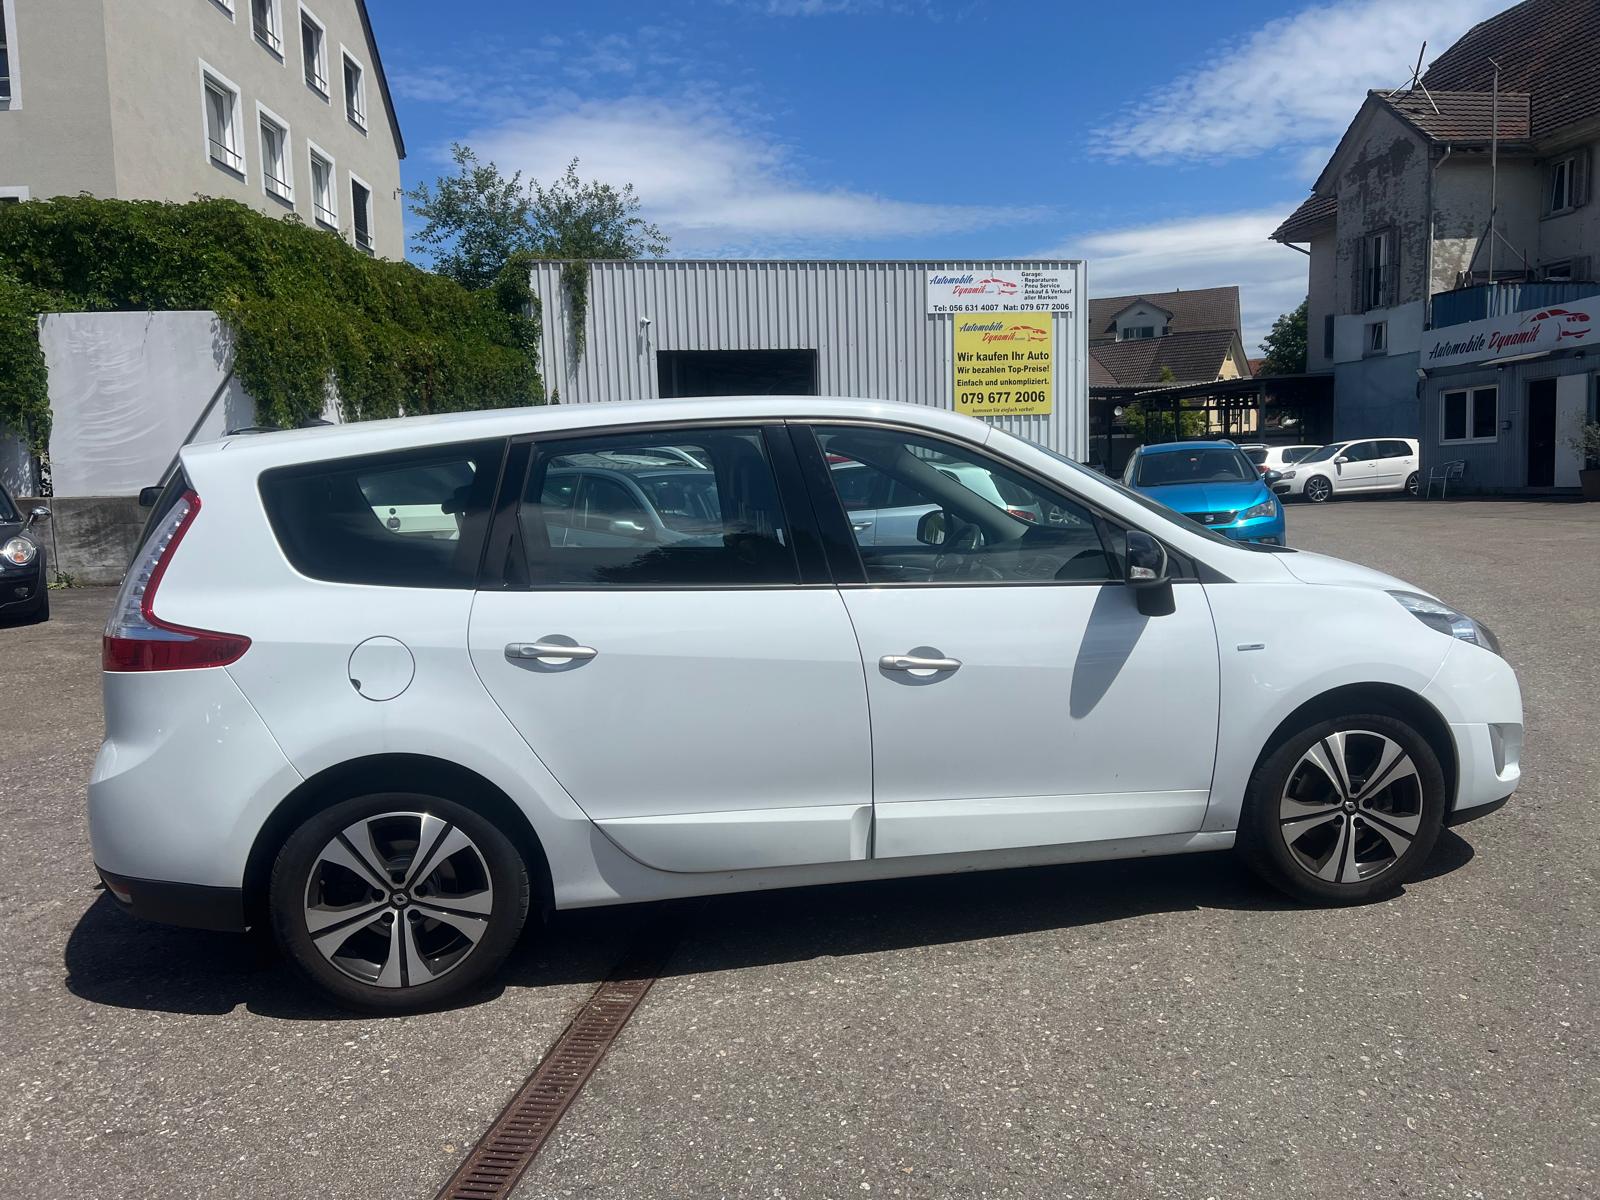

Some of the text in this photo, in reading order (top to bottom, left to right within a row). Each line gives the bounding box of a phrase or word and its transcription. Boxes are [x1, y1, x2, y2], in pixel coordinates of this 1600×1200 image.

[930, 274, 974, 284] Automobile
[953, 284, 986, 297] Dynamik
[960, 321, 1003, 332] Automobile
[982, 331, 1016, 344] Dynamik
[1429, 324, 1541, 360] Automobile Dynamik
[957, 351, 1049, 361] Wir kaufen Ihr Auto
[972, 365, 1005, 374] bezahlen
[1008, 365, 1049, 375] Top-Preise!
[957, 379, 983, 387] Einfach
[1000, 378, 1049, 387] unkompliziert.
[961, 391, 1045, 404] 079 677 2006
